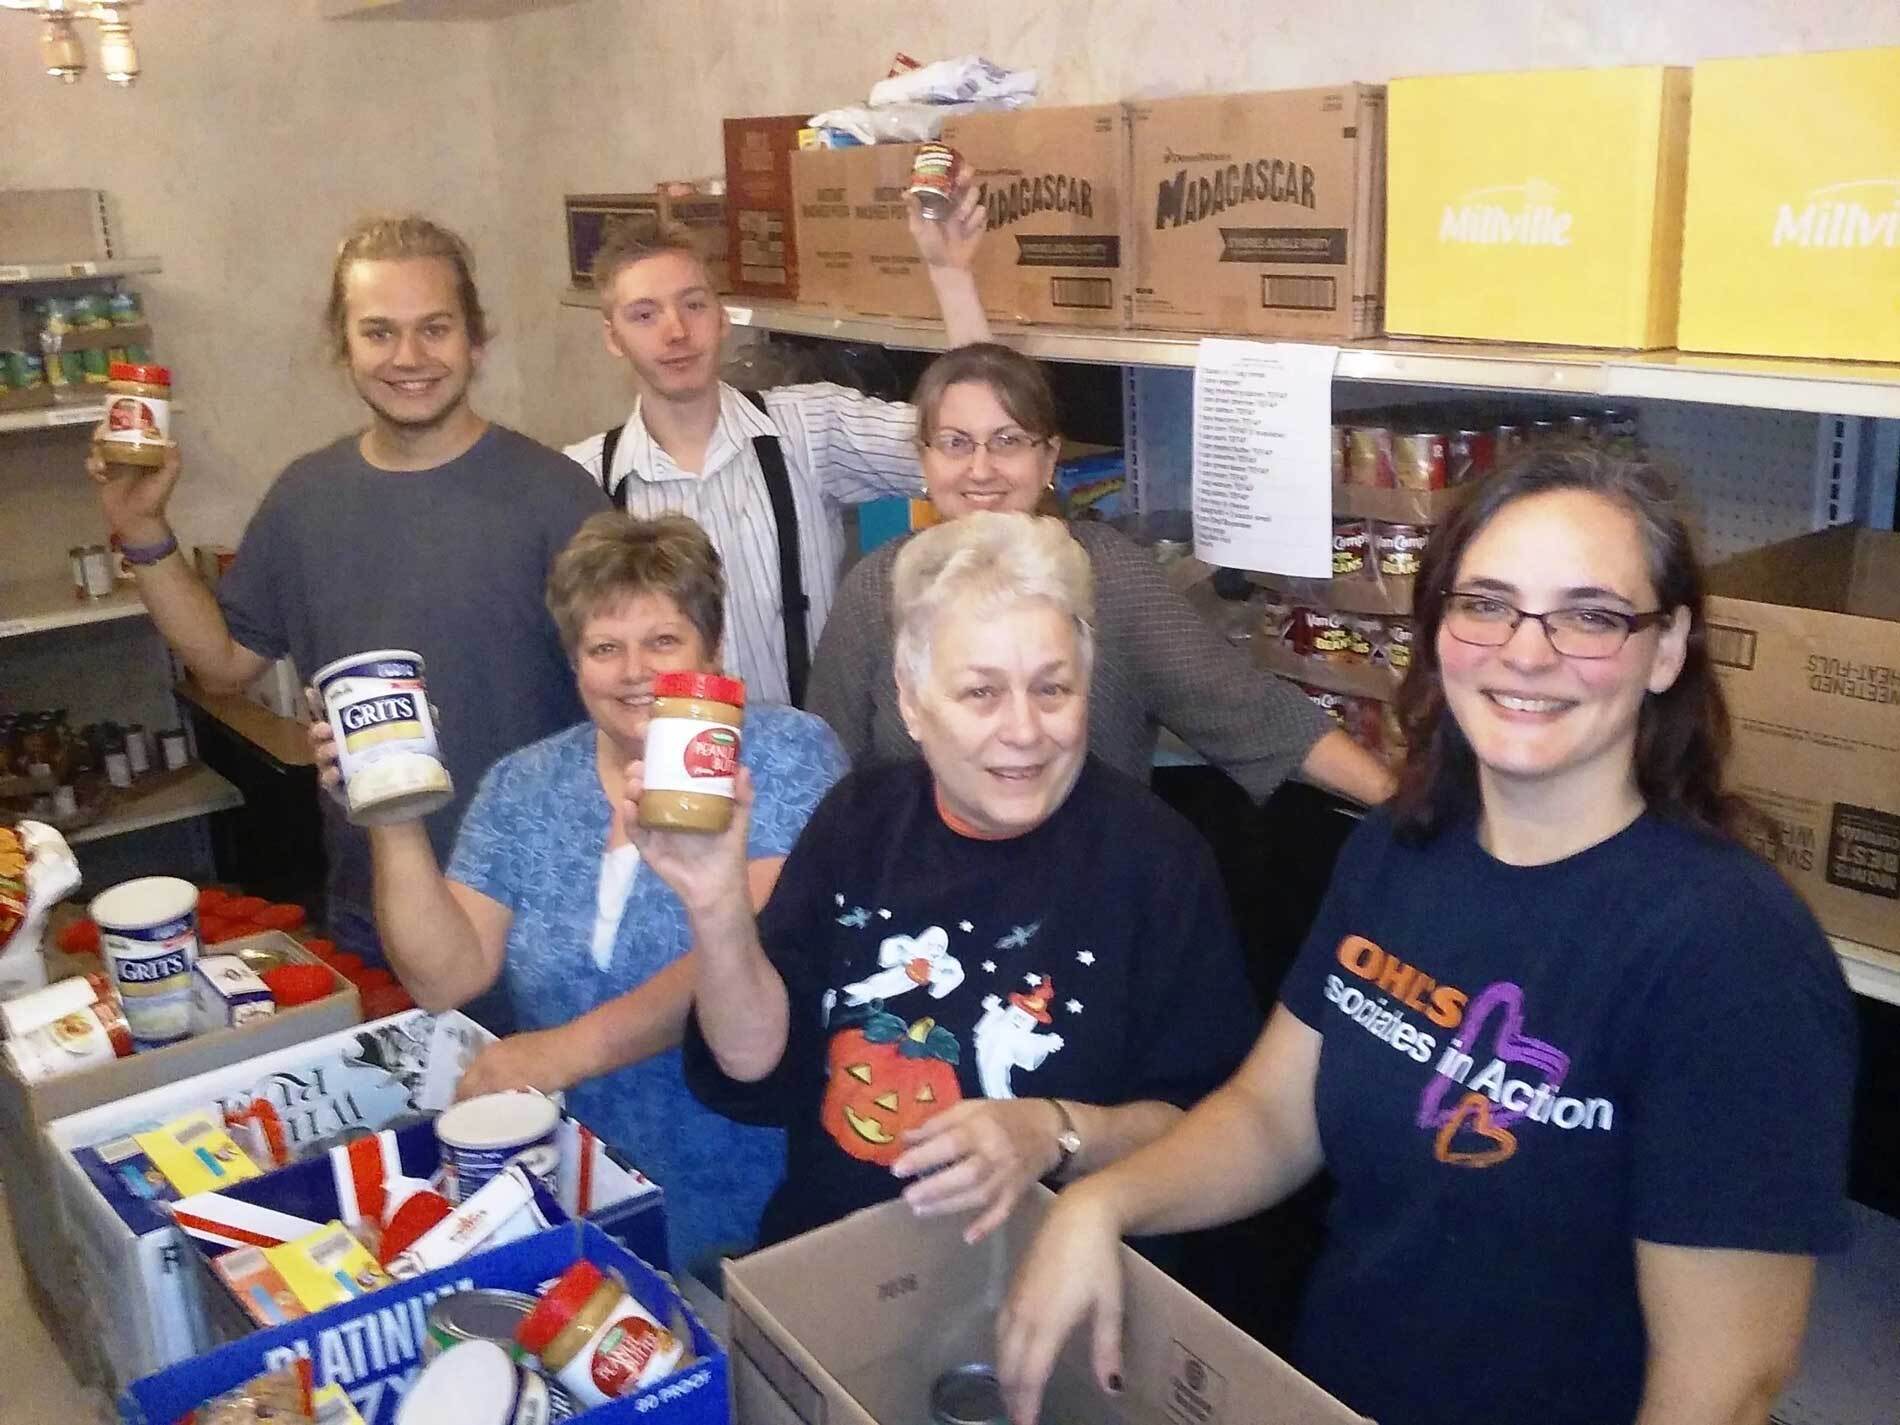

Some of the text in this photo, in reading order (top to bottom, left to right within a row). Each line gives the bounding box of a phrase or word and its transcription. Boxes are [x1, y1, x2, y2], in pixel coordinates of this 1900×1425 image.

[976, 174, 1093, 230] ADAGASCAR
[1155, 159, 1316, 229] MADAGASCAR
[1439, 203, 1573, 246] Millville
[345, 695, 413, 730] GRITS
[119, 953, 184, 982] GRITS
[1434, 1038, 1475, 1085] in
[1465, 1058, 1616, 1132] Action
